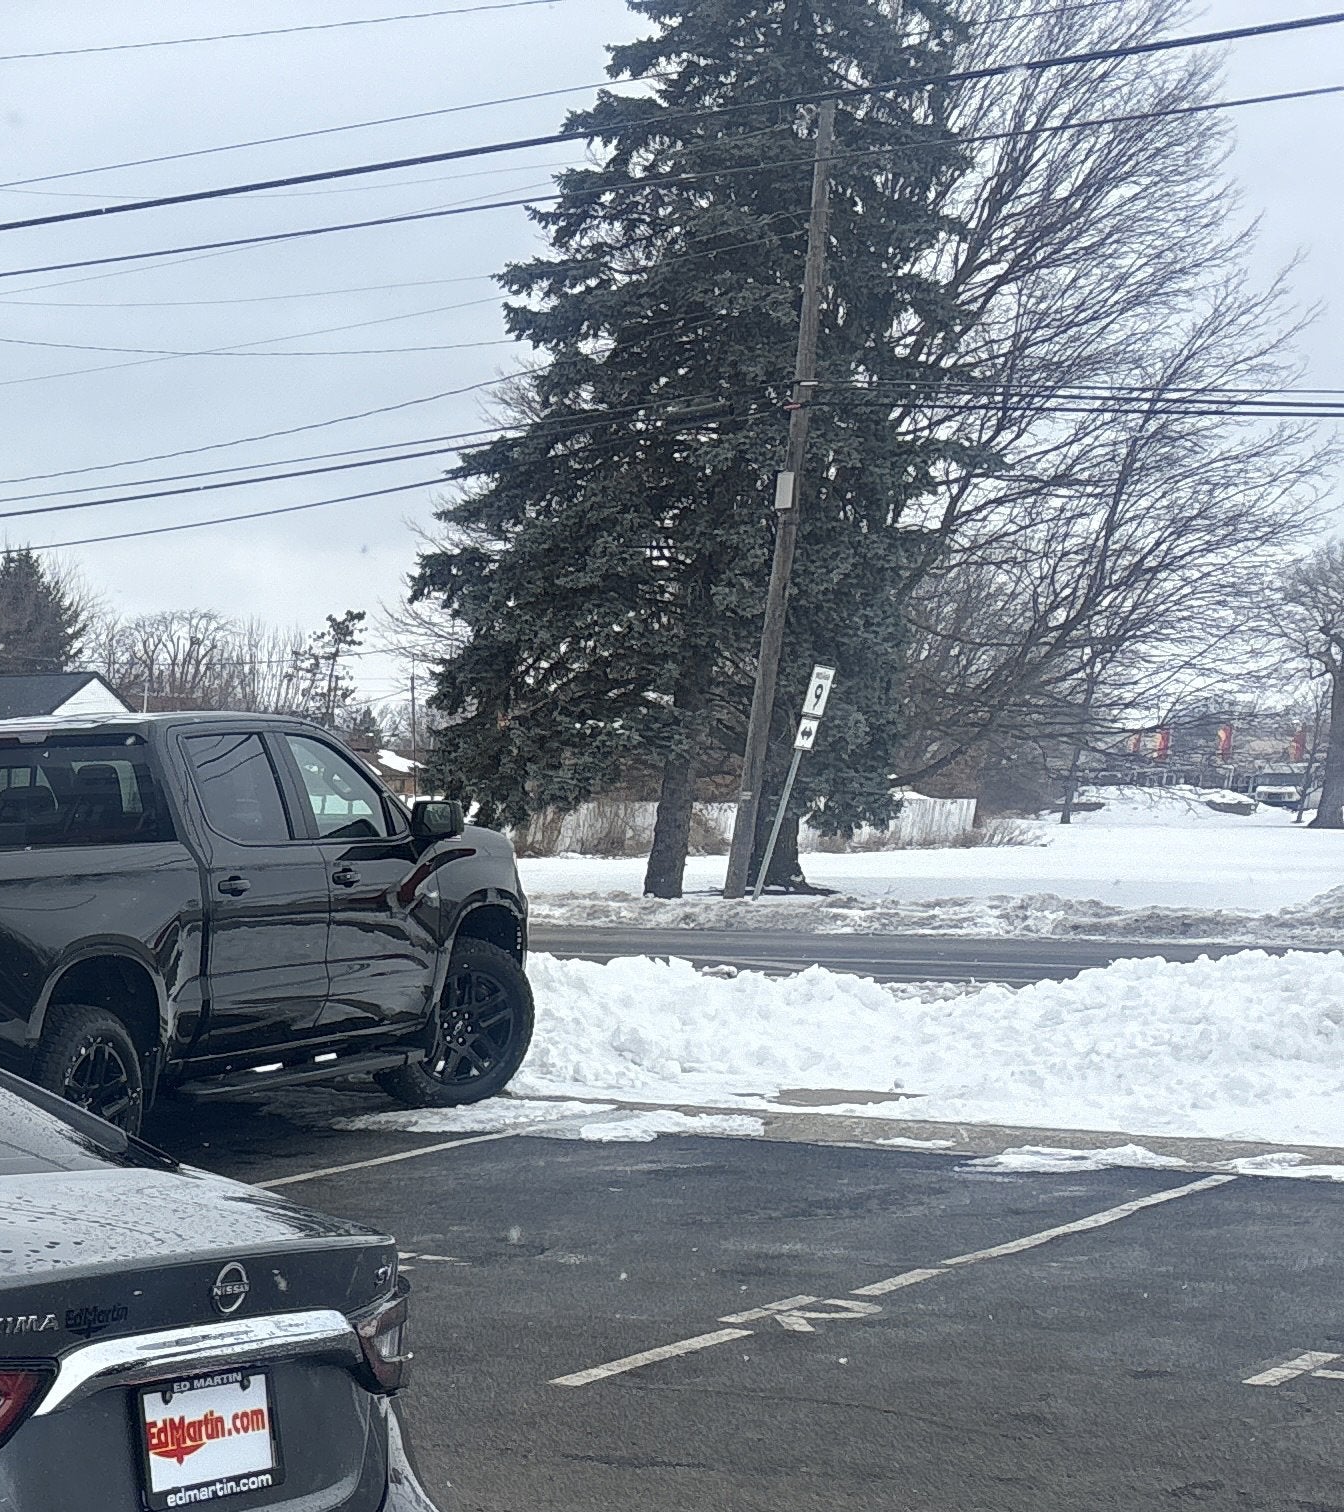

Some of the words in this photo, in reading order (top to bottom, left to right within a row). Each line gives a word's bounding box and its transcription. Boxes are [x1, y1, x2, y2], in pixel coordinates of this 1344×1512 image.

[812, 683, 824, 711] 9
[212, 1282, 250, 1296] NISSAN
[173, 1381, 191, 1392] ED
[193, 1372, 242, 1389] MARTIN
[146, 1408, 266, 1449] EdMartin.com
[166, 1473, 273, 1507] edmartin.com
